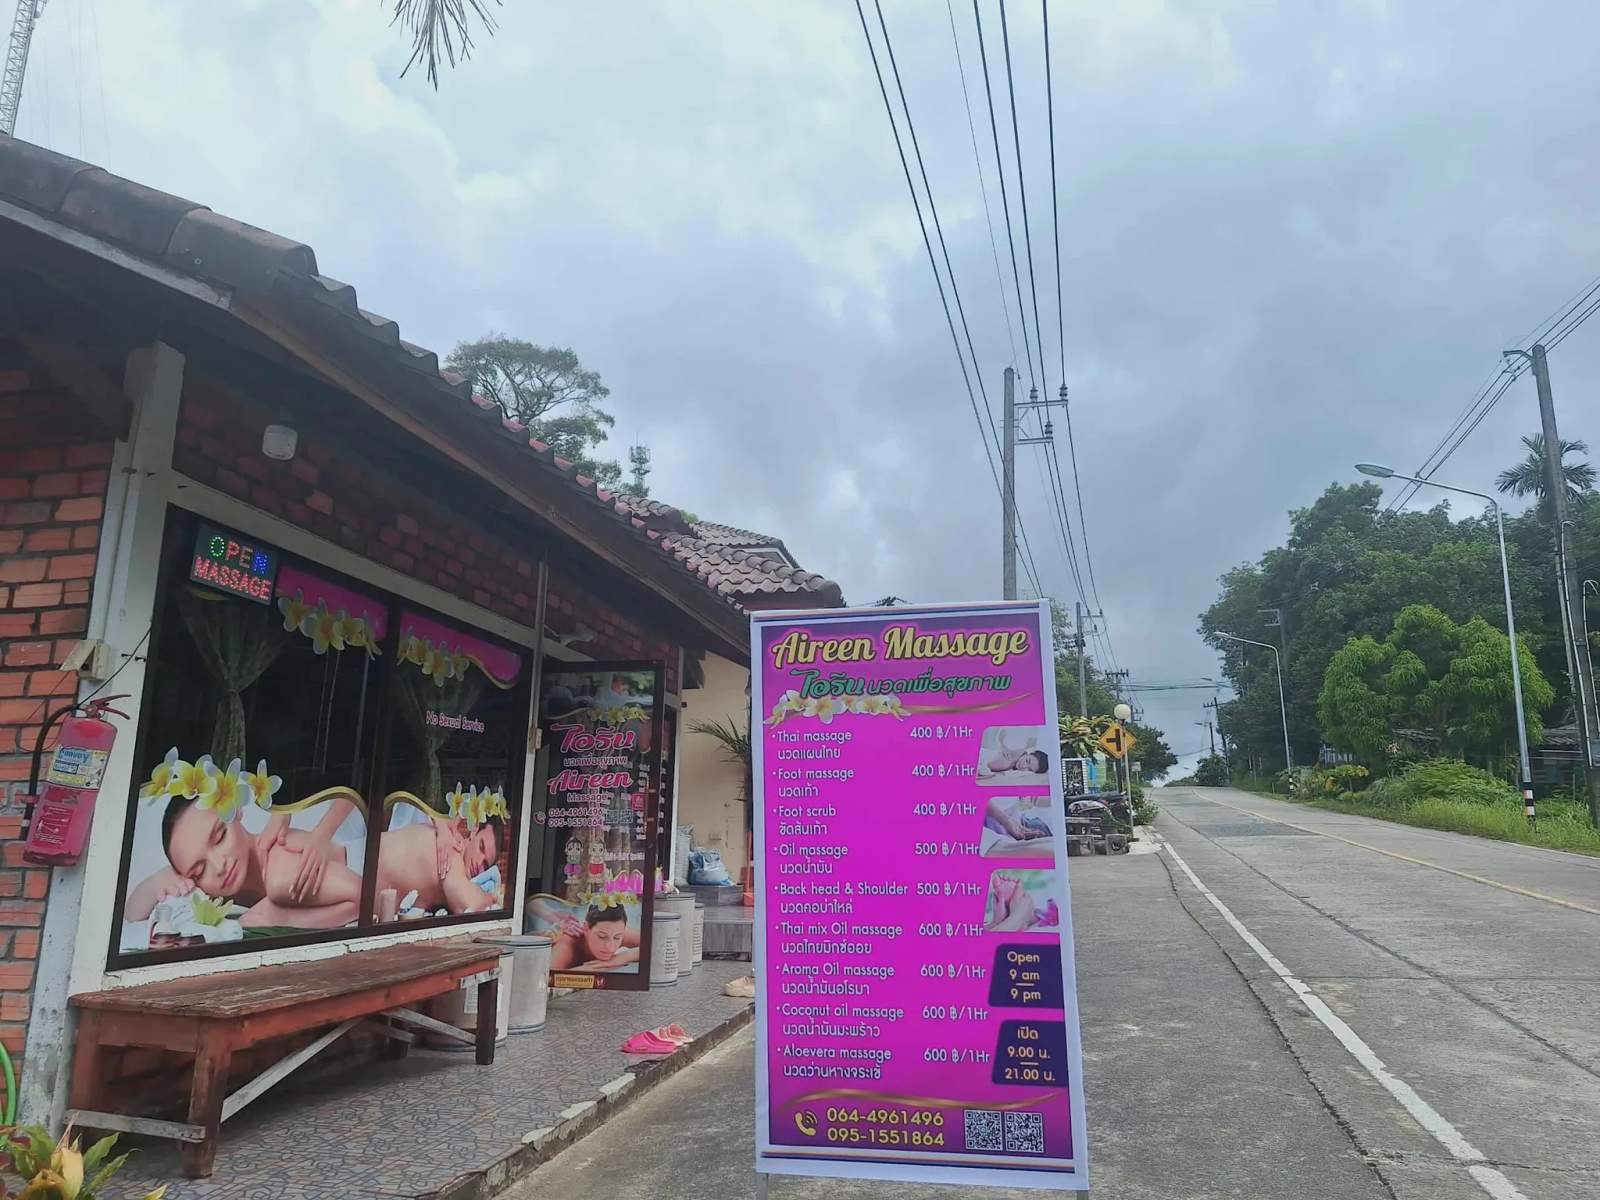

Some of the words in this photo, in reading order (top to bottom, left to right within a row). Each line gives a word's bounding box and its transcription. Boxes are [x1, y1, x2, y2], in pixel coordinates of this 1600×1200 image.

[210, 535, 270, 575] OPEN
[194, 555, 272, 601] MASSAGE
[771, 630, 876, 669] Aireen
[884, 625, 1030, 666] Massage
[790, 668, 865, 699] ไอรีน
[867, 666, 1012, 698] นวดเพื่อสุขภาพ
[426, 710, 438, 725] No
[439, 712, 461, 729] Sexual
[462, 716, 484, 733] Service
[550, 723, 635, 753] ไอรีน
[777, 730, 800, 743] Thai
[803, 731, 852, 744] massage
[910, 727, 933, 738] 400
[777, 745, 842, 760] นวดแผนไทย
[547, 769, 634, 794] Aireen
[778, 767, 802, 780] Foot
[805, 768, 855, 782] massage
[911, 764, 934, 777] 400
[778, 783, 819, 797] นวดเท้า
[779, 805, 803, 818] Foot
[806, 803, 837, 818] scrub
[912, 802, 936, 816] 400
[779, 842, 796, 856] Oil
[799, 845, 849, 859] massage
[914, 842, 938, 855] 500
[780, 858, 833, 874] นวดน้ำมัน
[780, 882, 807, 895] Back
[811, 881, 841, 895] head
[844, 882, 854, 895] &
[857, 881, 909, 896] Shoulder
[916, 882, 940, 896] 500
[781, 921, 805, 935] Thai
[808, 922, 828, 936] mix
[831, 921, 848, 935] Oil
[851, 924, 904, 940] massage
[918, 923, 942, 937] 600
[1007, 951, 1040, 966] Open
[781, 963, 819, 976] Aroma
[822, 962, 840, 976] Oil
[843, 965, 895, 980] massage
[920, 964, 944, 978] 600
[1009, 968, 1017, 980] 9
[1021, 972, 1040, 980] am
[1010, 988, 1018, 999] 9
[1023, 991, 1041, 1003] pm
[781, 1003, 830, 1017] Coconut
[834, 1002, 849, 1017] oil
[852, 1005, 904, 1021] massage
[922, 1006, 946, 1020] 600
[782, 1018, 881, 1037] นวดน้ำมันมะพร้าว
[1017, 1026, 1039, 1040] เปิด
[783, 1043, 836, 1057] Aloevera
[839, 1046, 892, 1063] massage
[923, 1048, 947, 1062] 600
[1007, 1046, 1034, 1058] 9.00
[1038, 1048, 1051, 1059] น.
[1005, 1068, 1039, 1081] 21.00
[1043, 1070, 1056, 1081] น.
[826, 1107, 944, 1126] 064-4961496
[827, 1127, 945, 1146] 095-1551864
